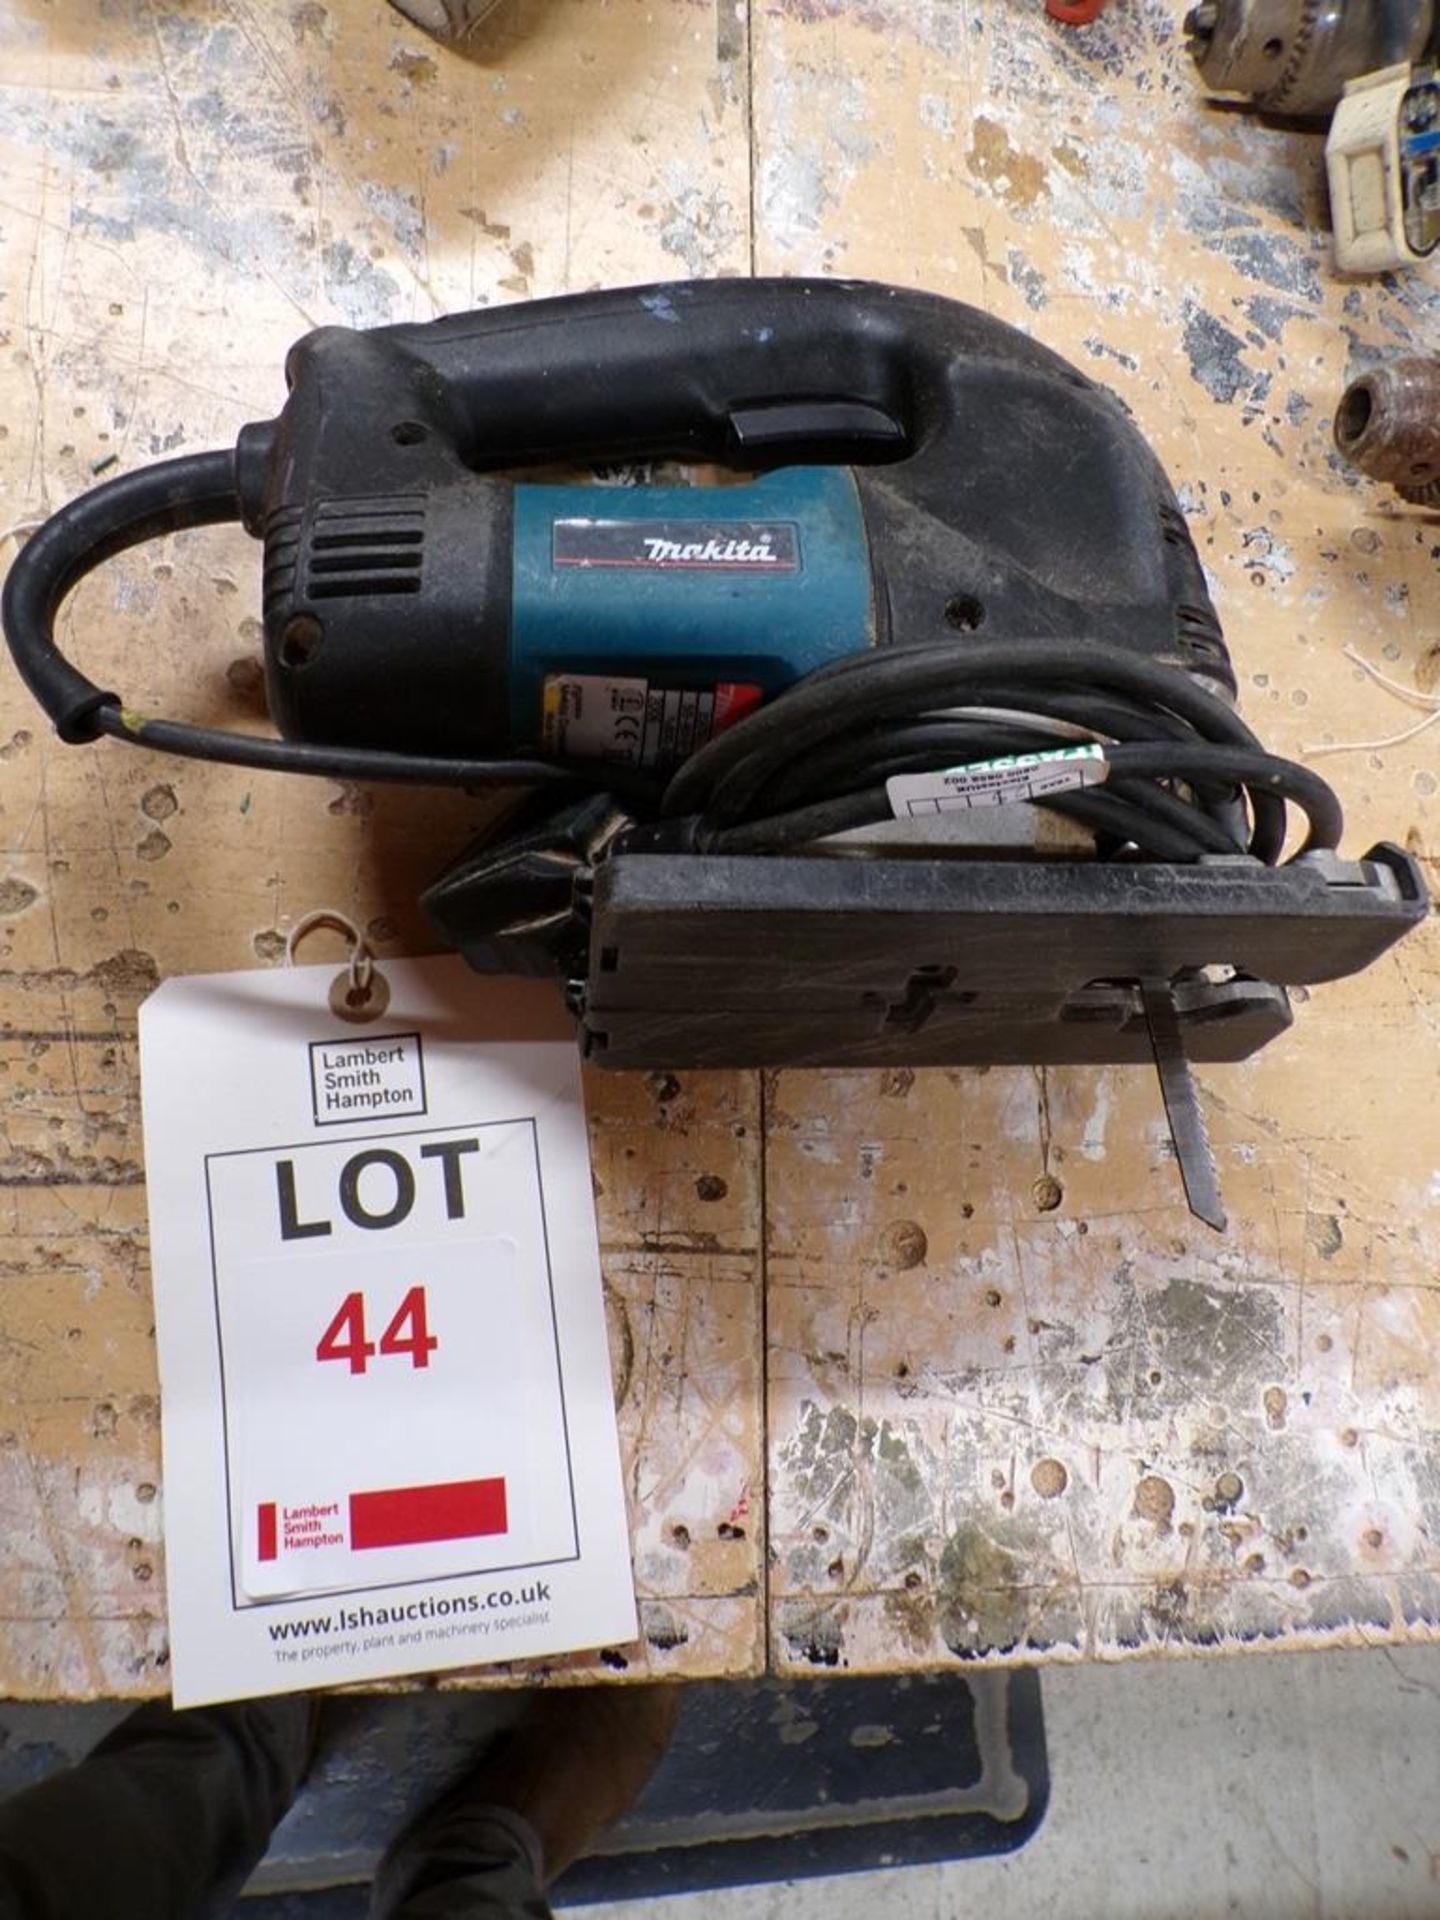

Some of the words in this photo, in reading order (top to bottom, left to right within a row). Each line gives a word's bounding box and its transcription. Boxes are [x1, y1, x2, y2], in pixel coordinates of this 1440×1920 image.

[323, 1045, 404, 1070] Lambert
[325, 1069, 380, 1090] Smith
[326, 1088, 413, 1109] Hampton
[276, 1138, 480, 1241] LOT
[316, 1285, 438, 1376] 44
[284, 1503, 339, 1520] Lambert
[284, 1519, 322, 1535] Smith
[284, 1532, 344, 1549] Hampton
[269, 1581, 551, 1641] www.lshauctions.co.uk
[275, 1650, 298, 1664] The
[301, 1640, 360, 1661] property,
[363, 1634, 395, 1653] plant
[398, 1630, 421, 1646] and
[425, 1621, 490, 1641] machinery
[494, 1611, 551, 1633] specialist
